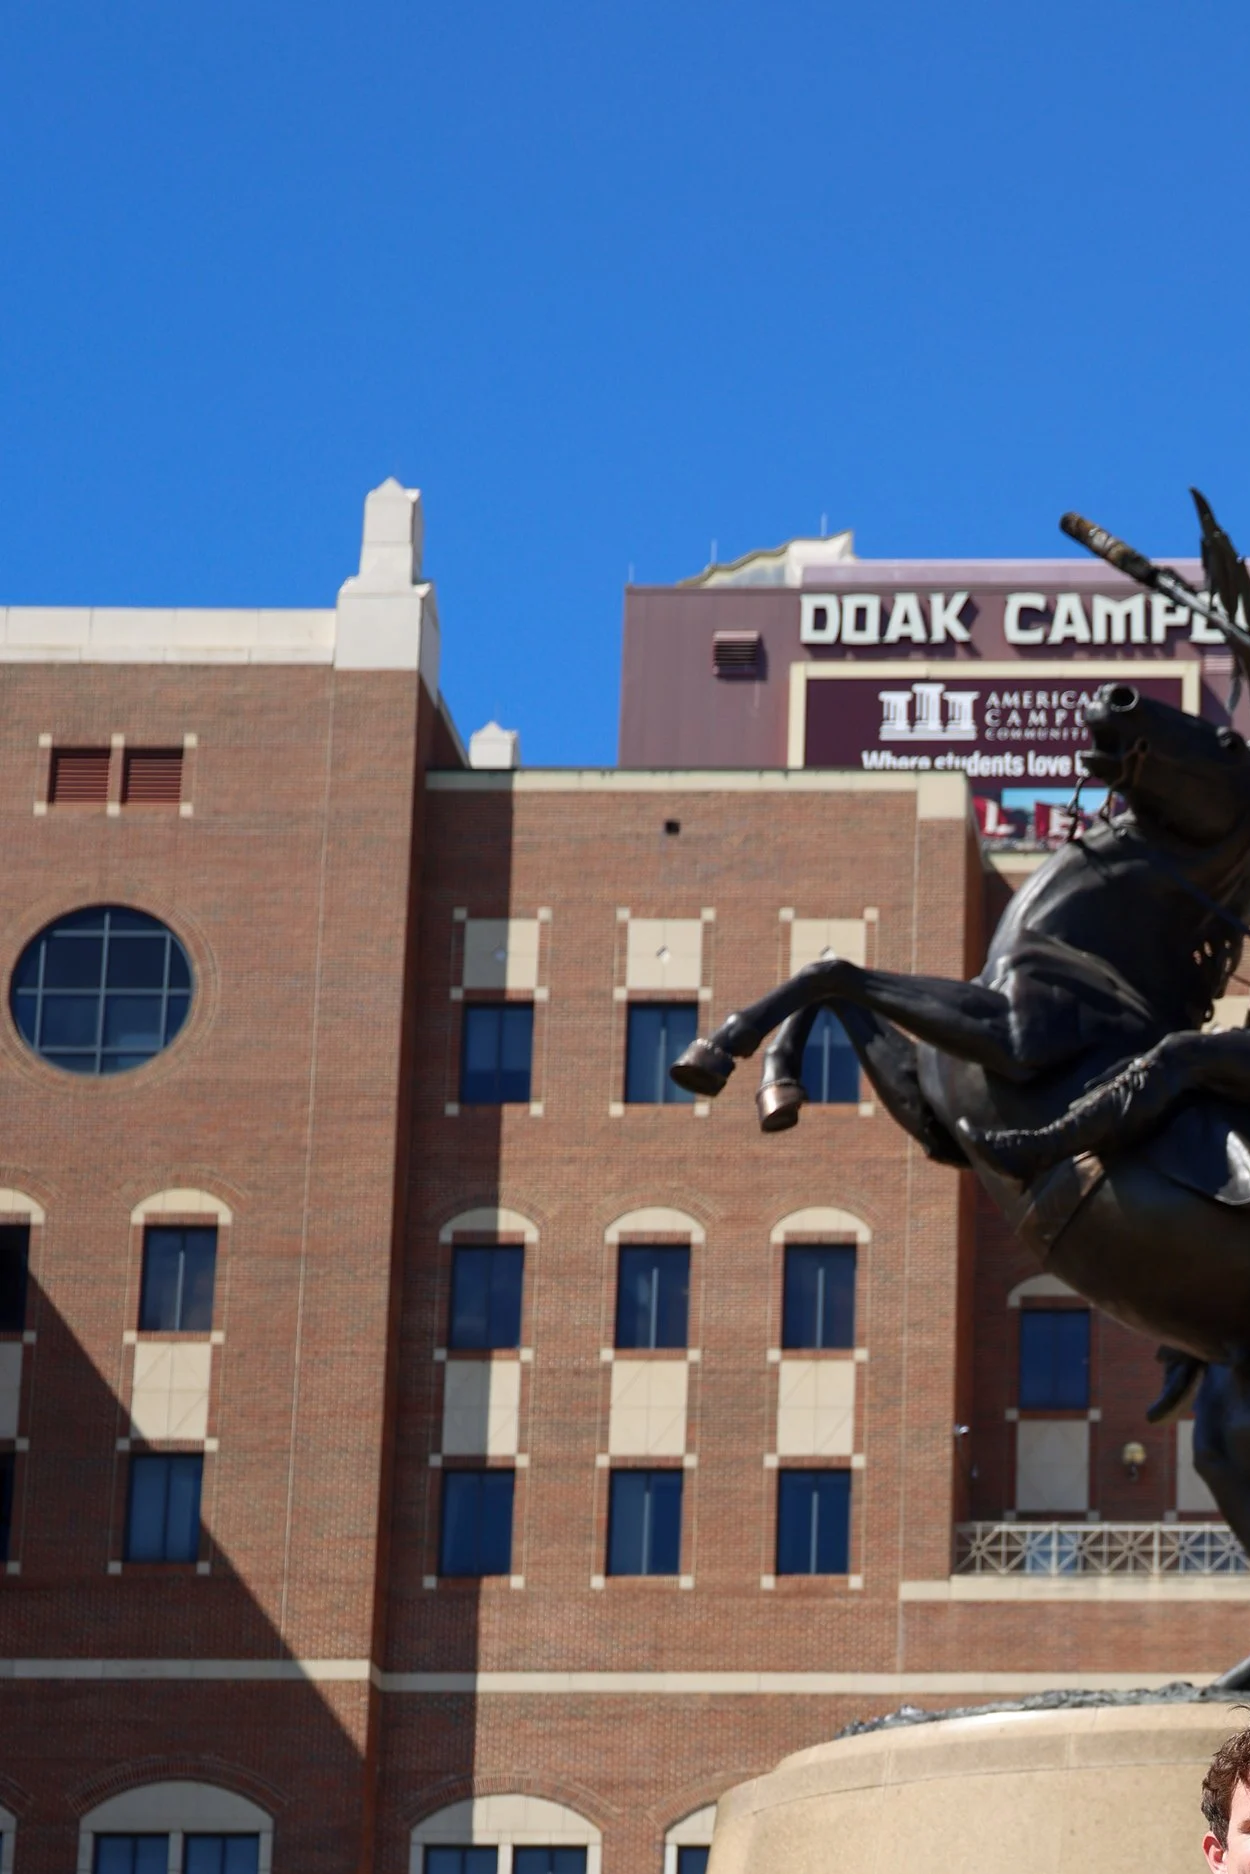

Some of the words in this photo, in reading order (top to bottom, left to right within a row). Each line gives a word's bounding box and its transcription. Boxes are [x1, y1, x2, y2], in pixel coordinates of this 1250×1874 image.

[800, 591, 970, 644] DOAK
[985, 690, 1097, 709] AMERICA
[984, 709, 1087, 727] CAMPU
[985, 727, 1089, 741] COMMUNITI
[934, 751, 1025, 777] students
[1028, 751, 1072, 777] love
